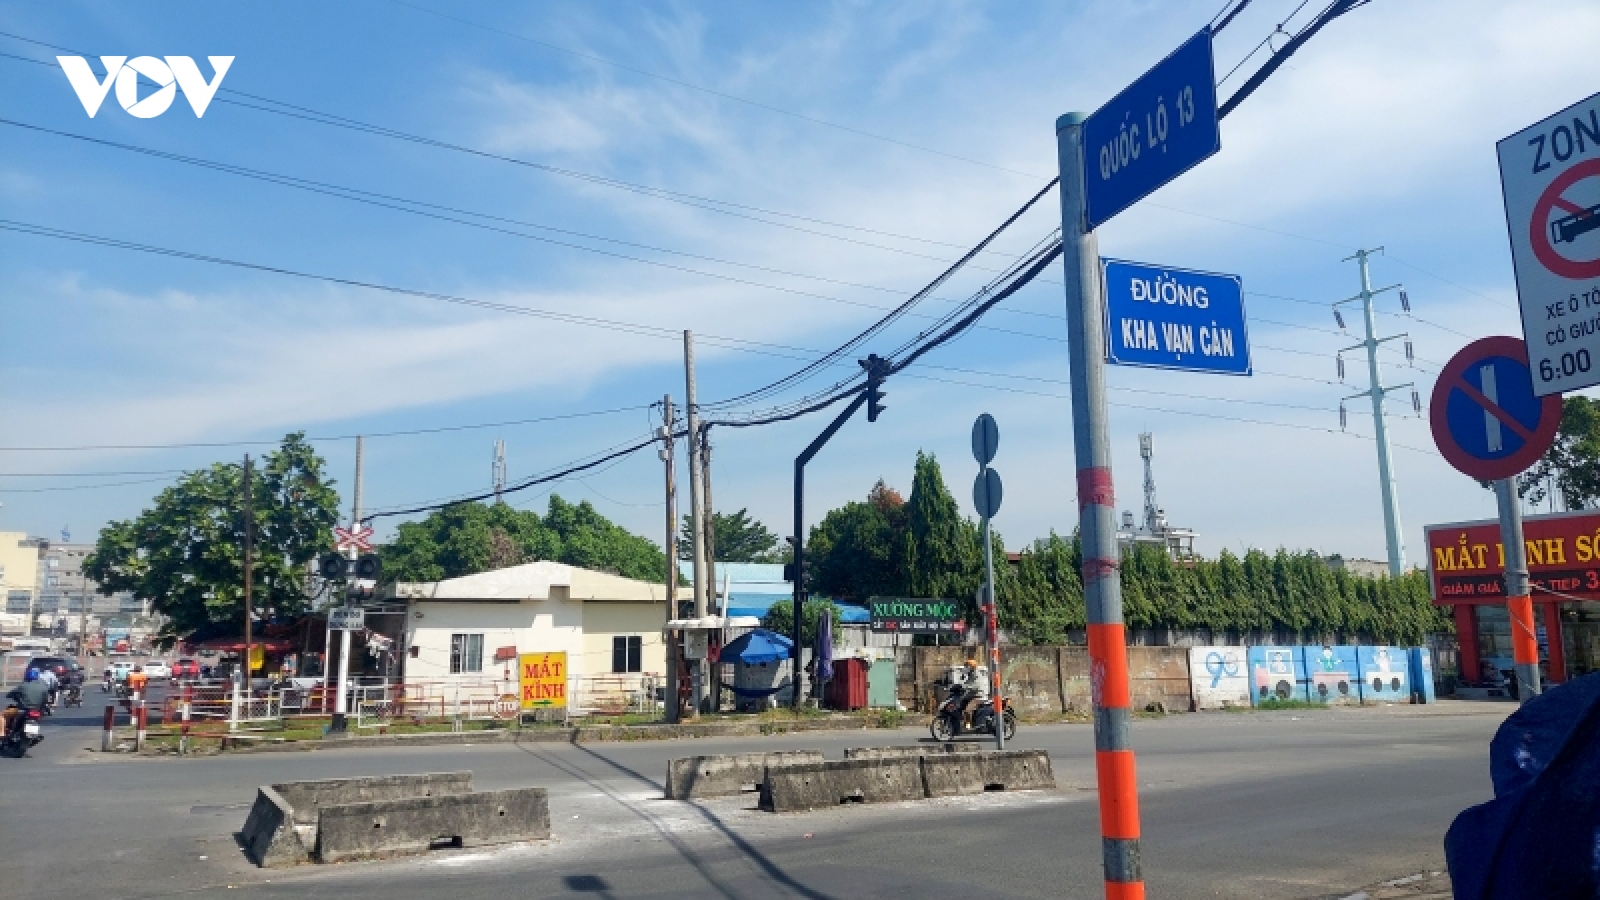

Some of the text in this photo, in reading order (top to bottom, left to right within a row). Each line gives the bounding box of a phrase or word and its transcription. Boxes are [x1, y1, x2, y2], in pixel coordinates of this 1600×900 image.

[1100, 86, 1194, 180] QUỐC LỘ 13
[1130, 272, 1208, 308] ĐƯỜNG
[1546, 301, 1566, 320] XE
[1569, 294, 1579, 312] Ô
[1122, 318, 1158, 350] KHA
[1162, 322, 1194, 360] VẠN
[1546, 324, 1566, 346] CÓ
[1540, 348, 1591, 382] 6:00
[926, 600, 956, 620] MỘC
[523, 654, 562, 678] MẮT
[523, 680, 565, 700] KÍNH
